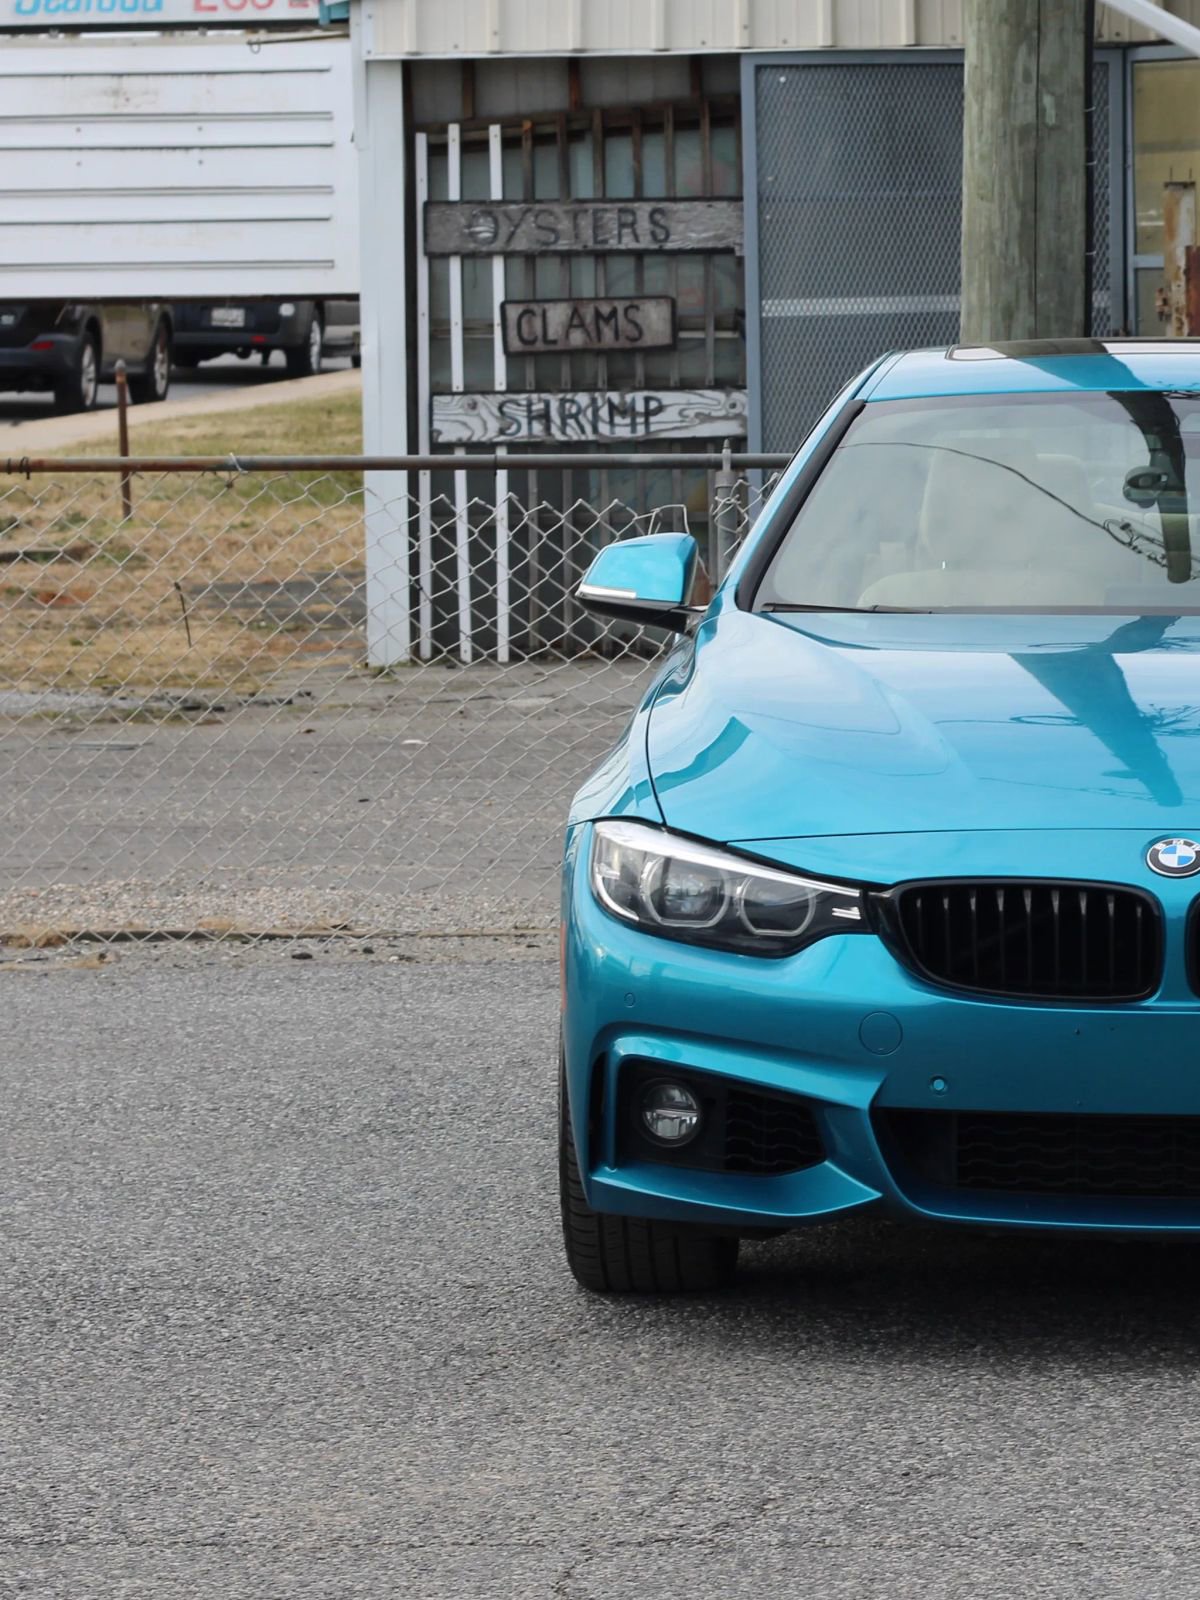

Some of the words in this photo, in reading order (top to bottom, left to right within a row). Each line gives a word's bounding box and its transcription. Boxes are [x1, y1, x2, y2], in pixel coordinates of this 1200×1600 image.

[465, 206, 672, 247] OYSTERS
[516, 304, 645, 347] CLAMS
[498, 395, 664, 437] SHRIMP
